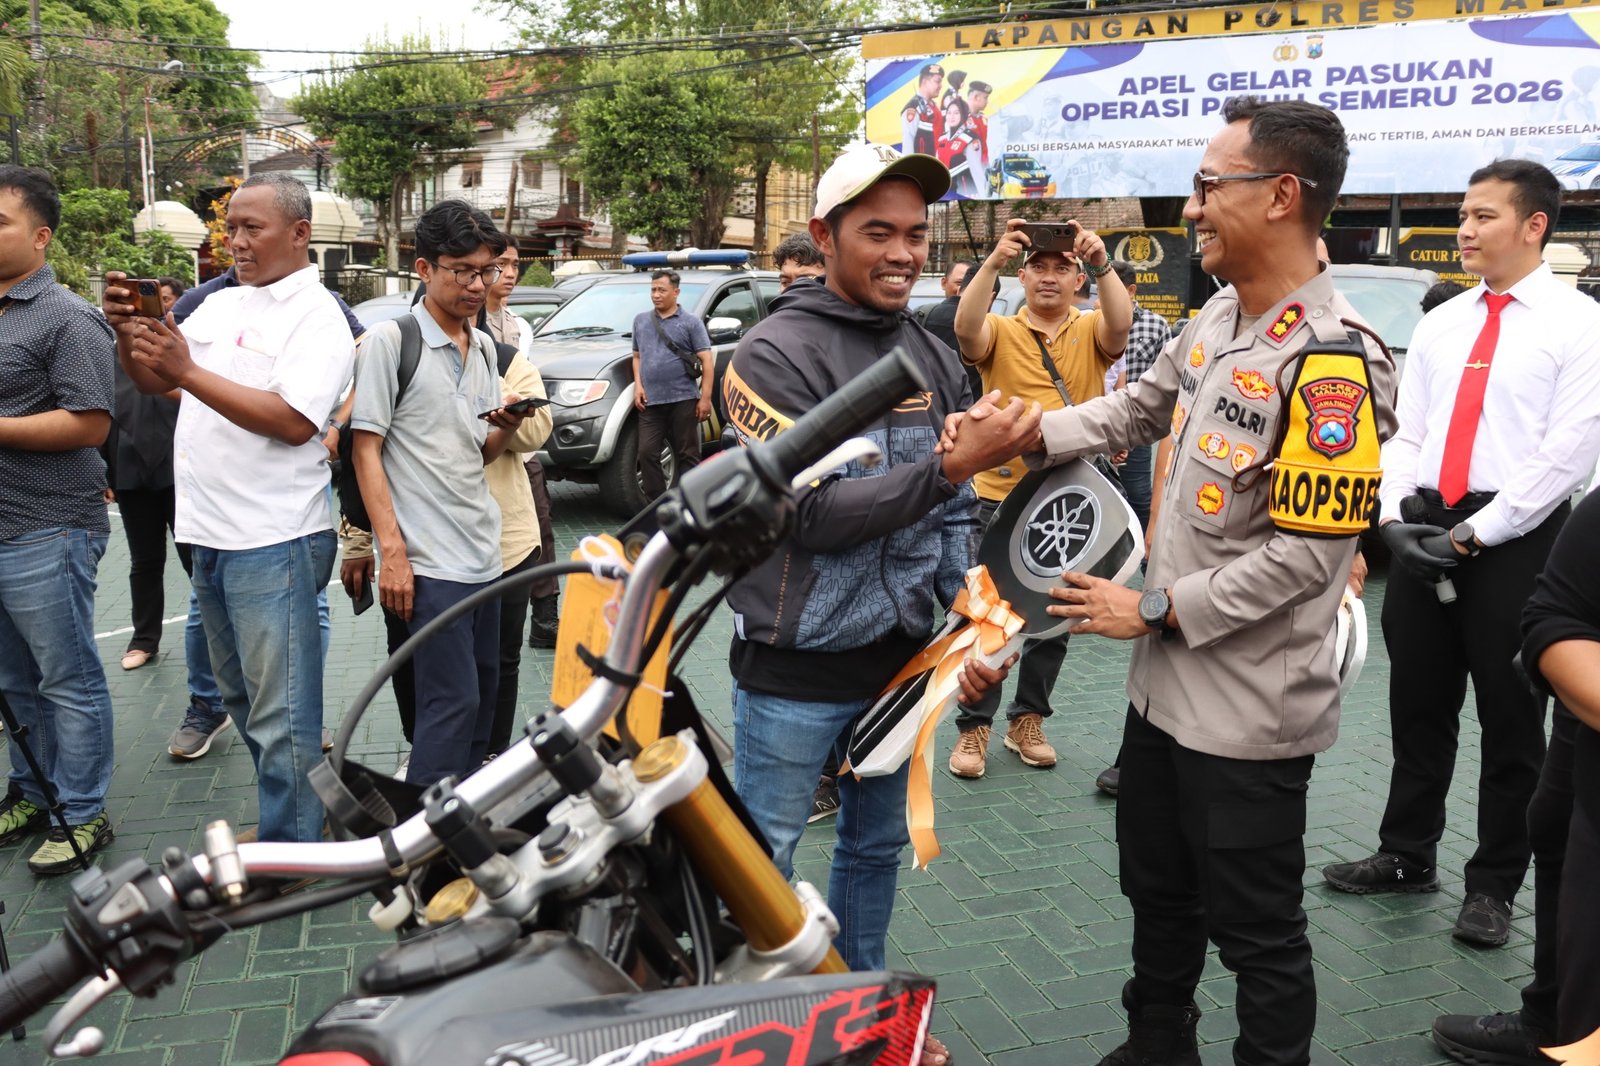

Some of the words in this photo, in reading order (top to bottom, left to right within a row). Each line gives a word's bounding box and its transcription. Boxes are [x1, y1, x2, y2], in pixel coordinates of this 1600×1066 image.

[954, 15, 1188, 49] LAPANGAN
[1224, 0, 1415, 31] POLRES
[1118, 75, 1195, 96] APEL
[1207, 69, 1312, 92] GELAR
[1326, 58, 1493, 87] PASUKAN
[1318, 86, 1457, 111] SEMERU
[1471, 79, 1563, 105] 2026
[1061, 97, 1189, 122] OPERASI
[1380, 130, 1428, 142] TERTIB,
[1432, 129, 1472, 139] AMAN
[1476, 128, 1505, 138] DAN
[1006, 143, 1039, 153] POLISI
[1042, 142, 1095, 152] BERSAMA
[1098, 138, 1173, 150] MASYARAKAT
[1411, 250, 1448, 261] CATUR
[1135, 273, 1159, 283] RATA
[1310, 383, 1360, 396] POLRES
[1315, 388, 1356, 399] MALANG
[1213, 396, 1267, 436] POLRI
